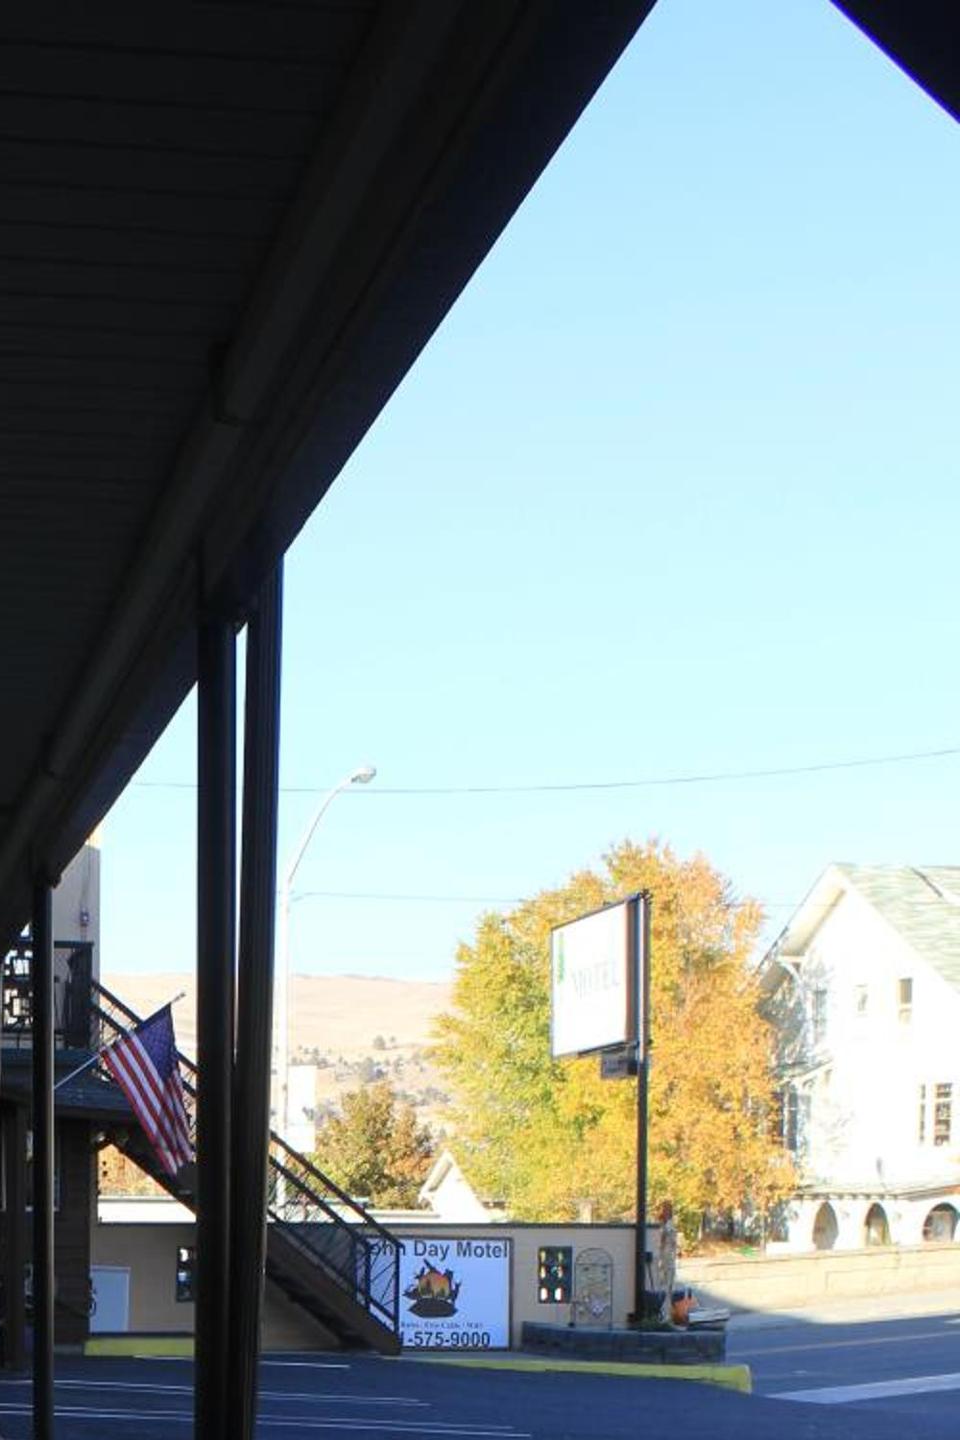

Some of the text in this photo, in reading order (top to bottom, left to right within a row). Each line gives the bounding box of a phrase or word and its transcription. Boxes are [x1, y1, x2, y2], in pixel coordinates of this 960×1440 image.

[367, 1239, 508, 1261] ohn Day Motel
